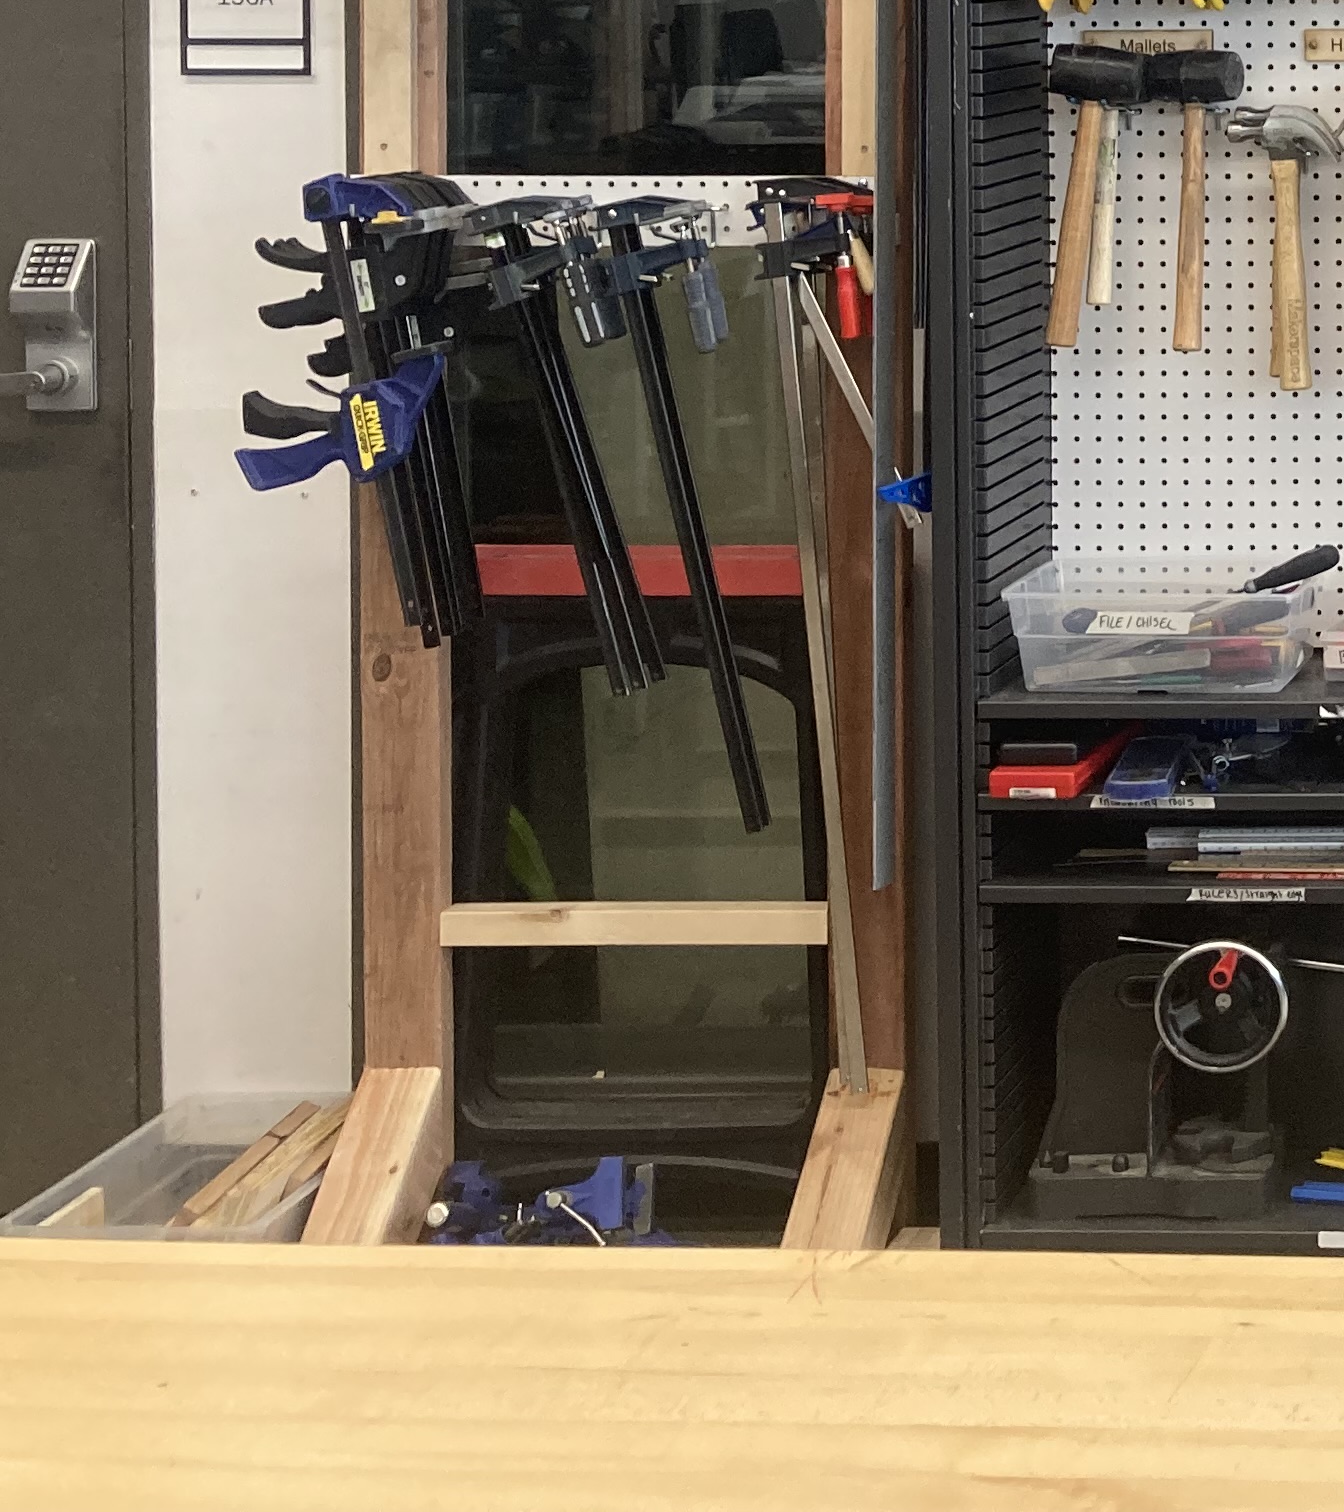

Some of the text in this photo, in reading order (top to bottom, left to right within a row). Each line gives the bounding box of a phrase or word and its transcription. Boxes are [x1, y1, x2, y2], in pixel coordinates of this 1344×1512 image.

[1120, 39, 1176, 54] Mallets
[363, 400, 387, 455] IRWIN
[1099, 614, 1123, 628] FILE
[1135, 616, 1177, 631] CHISEL
